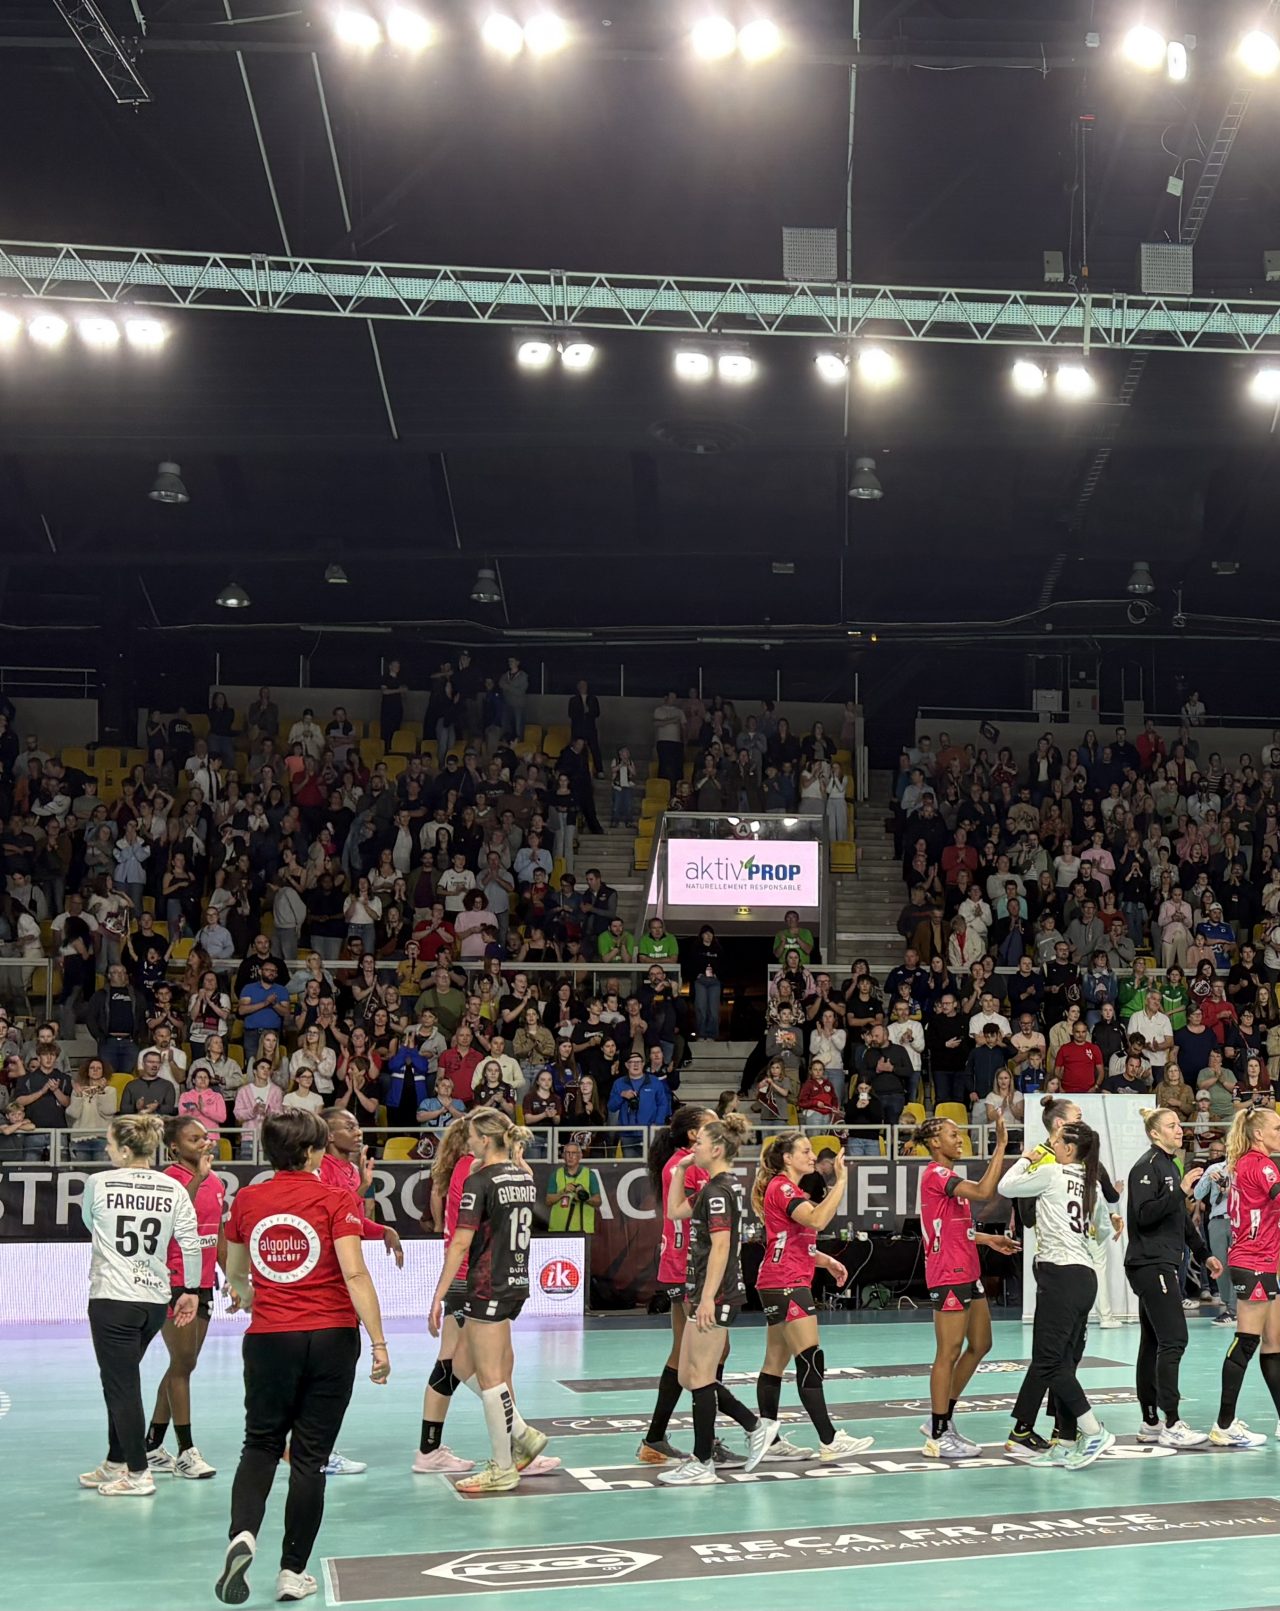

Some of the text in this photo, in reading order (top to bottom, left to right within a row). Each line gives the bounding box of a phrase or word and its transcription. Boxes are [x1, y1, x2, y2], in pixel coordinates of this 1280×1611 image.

[685, 883, 748, 891] NATURELLEMENT
[106, 1193, 173, 1213] FARGUES
[115, 1215, 162, 1258] 53
[509, 1207, 533, 1251] 13
[260, 1236, 307, 1254] algoplus
[546, 1262, 572, 1287] ik
[690, 1512, 1168, 1556] RECA FRANCE
[700, 1552, 792, 1564] RECA
